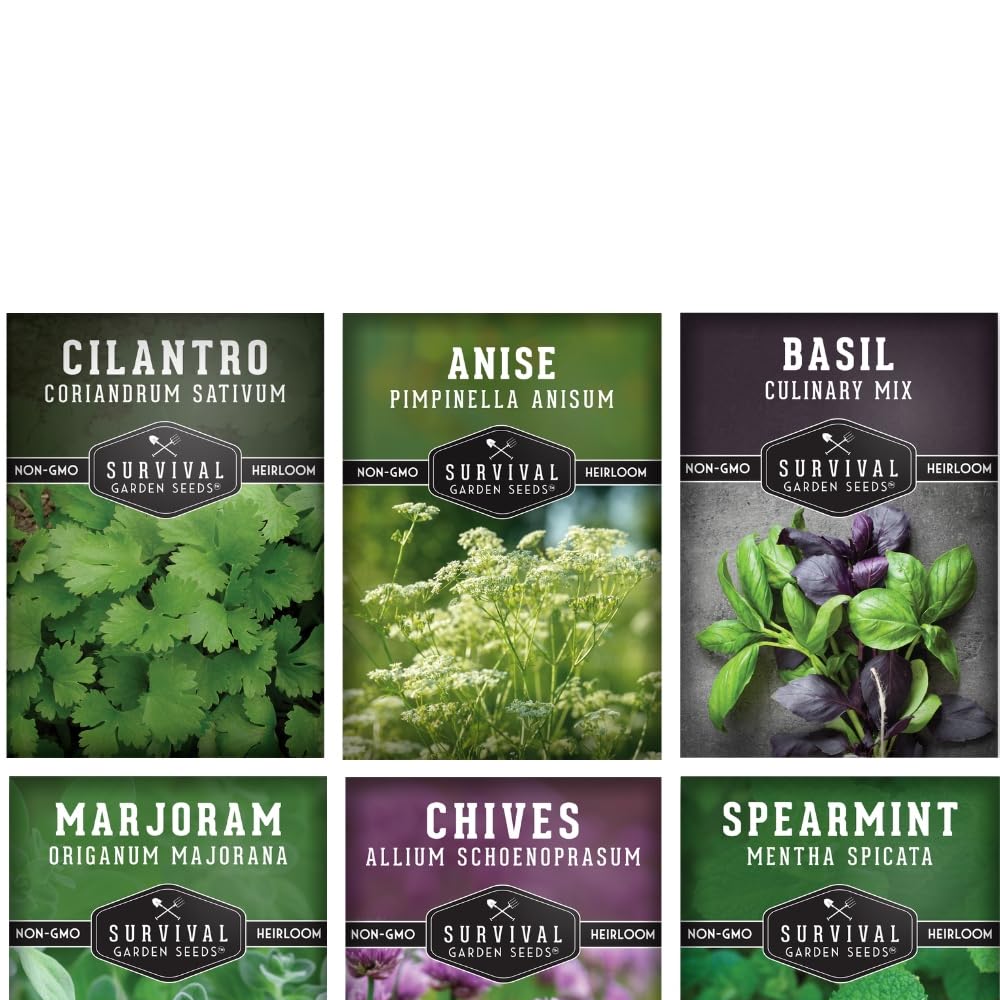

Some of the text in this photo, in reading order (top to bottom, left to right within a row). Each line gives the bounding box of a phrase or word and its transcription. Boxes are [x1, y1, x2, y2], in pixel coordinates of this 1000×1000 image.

[63, 340, 267, 375] CILANTRO
[783, 337, 894, 371] BASIL
[448, 347, 555, 379] ANISE
[45, 384, 285, 402] CORIANDRUM SATIVUM
[766, 381, 911, 399] CULINARY MIX
[391, 390, 613, 408] PIMPINELLA ANISUM
[15, 465, 78, 475] NON-GMO
[107, 462, 223, 478] SURVIVAL
[253, 465, 315, 475] HEIRLOOM
[358, 467, 418, 477] NON-GMO
[446, 464, 558, 480] SURVIVAL
[586, 467, 646, 477] HEIRLOOM
[686, 463, 750, 473] NON-GMO
[780, 460, 898, 477] SURVIVAL
[928, 463, 991, 473] HEIRLOOM
[112, 483, 163, 493] GARDEN
[450, 485, 500, 494] GARDEN
[784, 482, 837, 491] GARDEN
[56, 802, 281, 836] MARJORAM
[427, 802, 579, 839] CHIVES
[723, 802, 958, 836] SPEARMINT
[50, 846, 287, 865] ORIGANUM MAJORANA
[366, 847, 640, 866] ALLIUM SCHOENOPRASUM
[748, 847, 932, 865] MENTHA SPICATA
[17, 928, 80, 938] NON-GMO
[110, 925, 228, 942] SURVIVAL
[257, 928, 320, 938] HEIRLOOM
[352, 929, 415, 939] NON-GMO
[444, 926, 562, 943] SURVIVAL
[591, 929, 654, 939] HEIRLOOM
[688, 929, 752, 939] NON-GMO
[781, 925, 899, 942] SURVIVAL
[929, 929, 992, 939] HEIRLOOM
[114, 947, 167, 956] GARDEN
[449, 947, 501, 957] GARDEN
[786, 947, 838, 957] GARDEN
